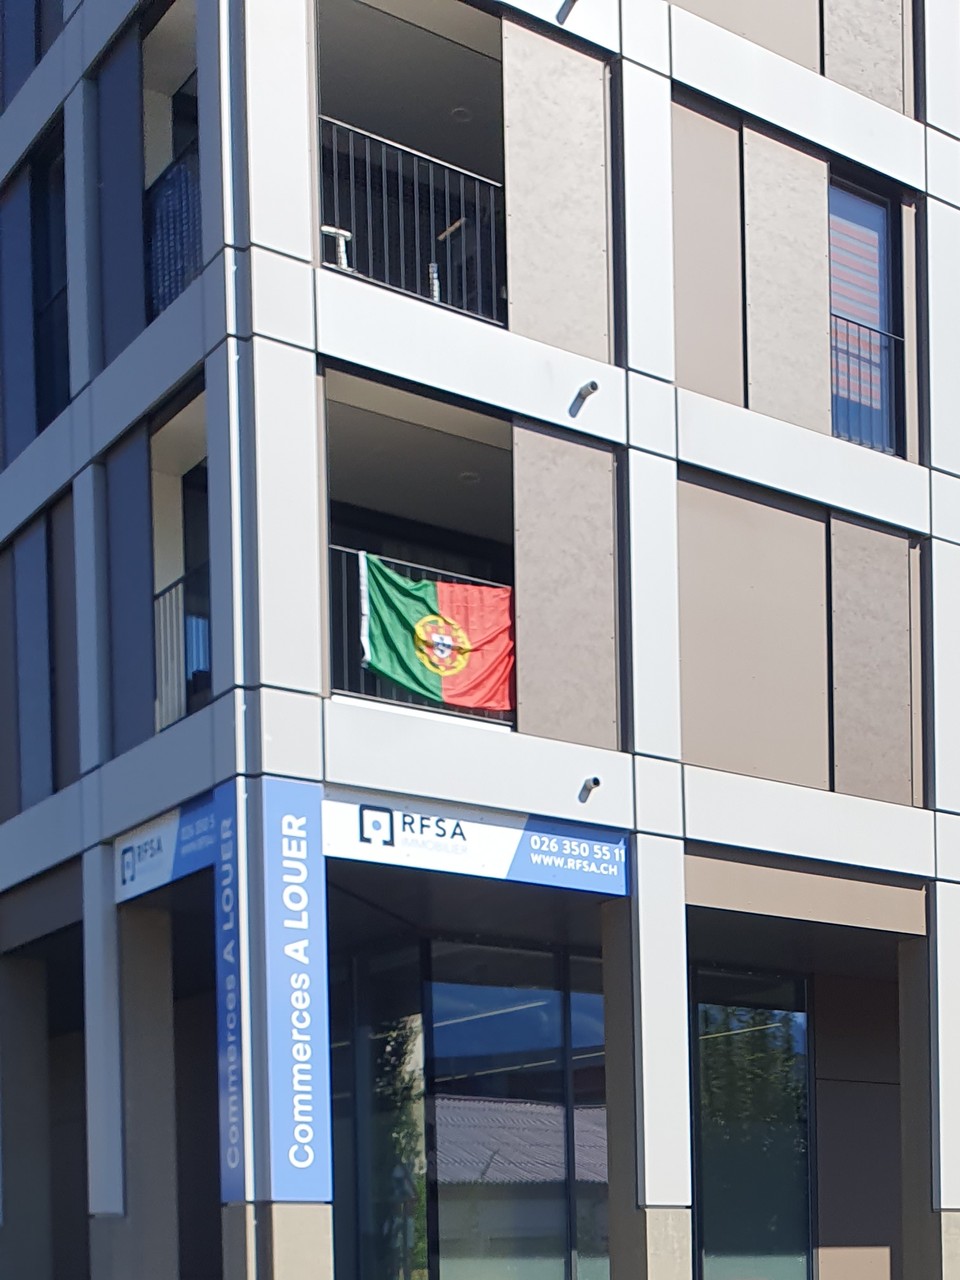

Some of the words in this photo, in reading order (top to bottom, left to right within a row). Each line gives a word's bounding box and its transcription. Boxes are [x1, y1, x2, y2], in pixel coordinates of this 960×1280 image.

[402, 813, 467, 841] RFSA
[530, 835, 559, 852] 026
[562, 840, 590, 857] 350
[593, 845, 611, 860] 55
[614, 847, 625, 863] 11
[221, 817, 235, 931] LOUER
[281, 814, 309, 930] LOUER
[530, 853, 618, 876] WWW.RFSA.CH
[222, 939, 235, 964] A
[284, 938, 310, 965] A
[225, 974, 240, 1169] Commerces
[288, 972, 315, 1169] Commerces
